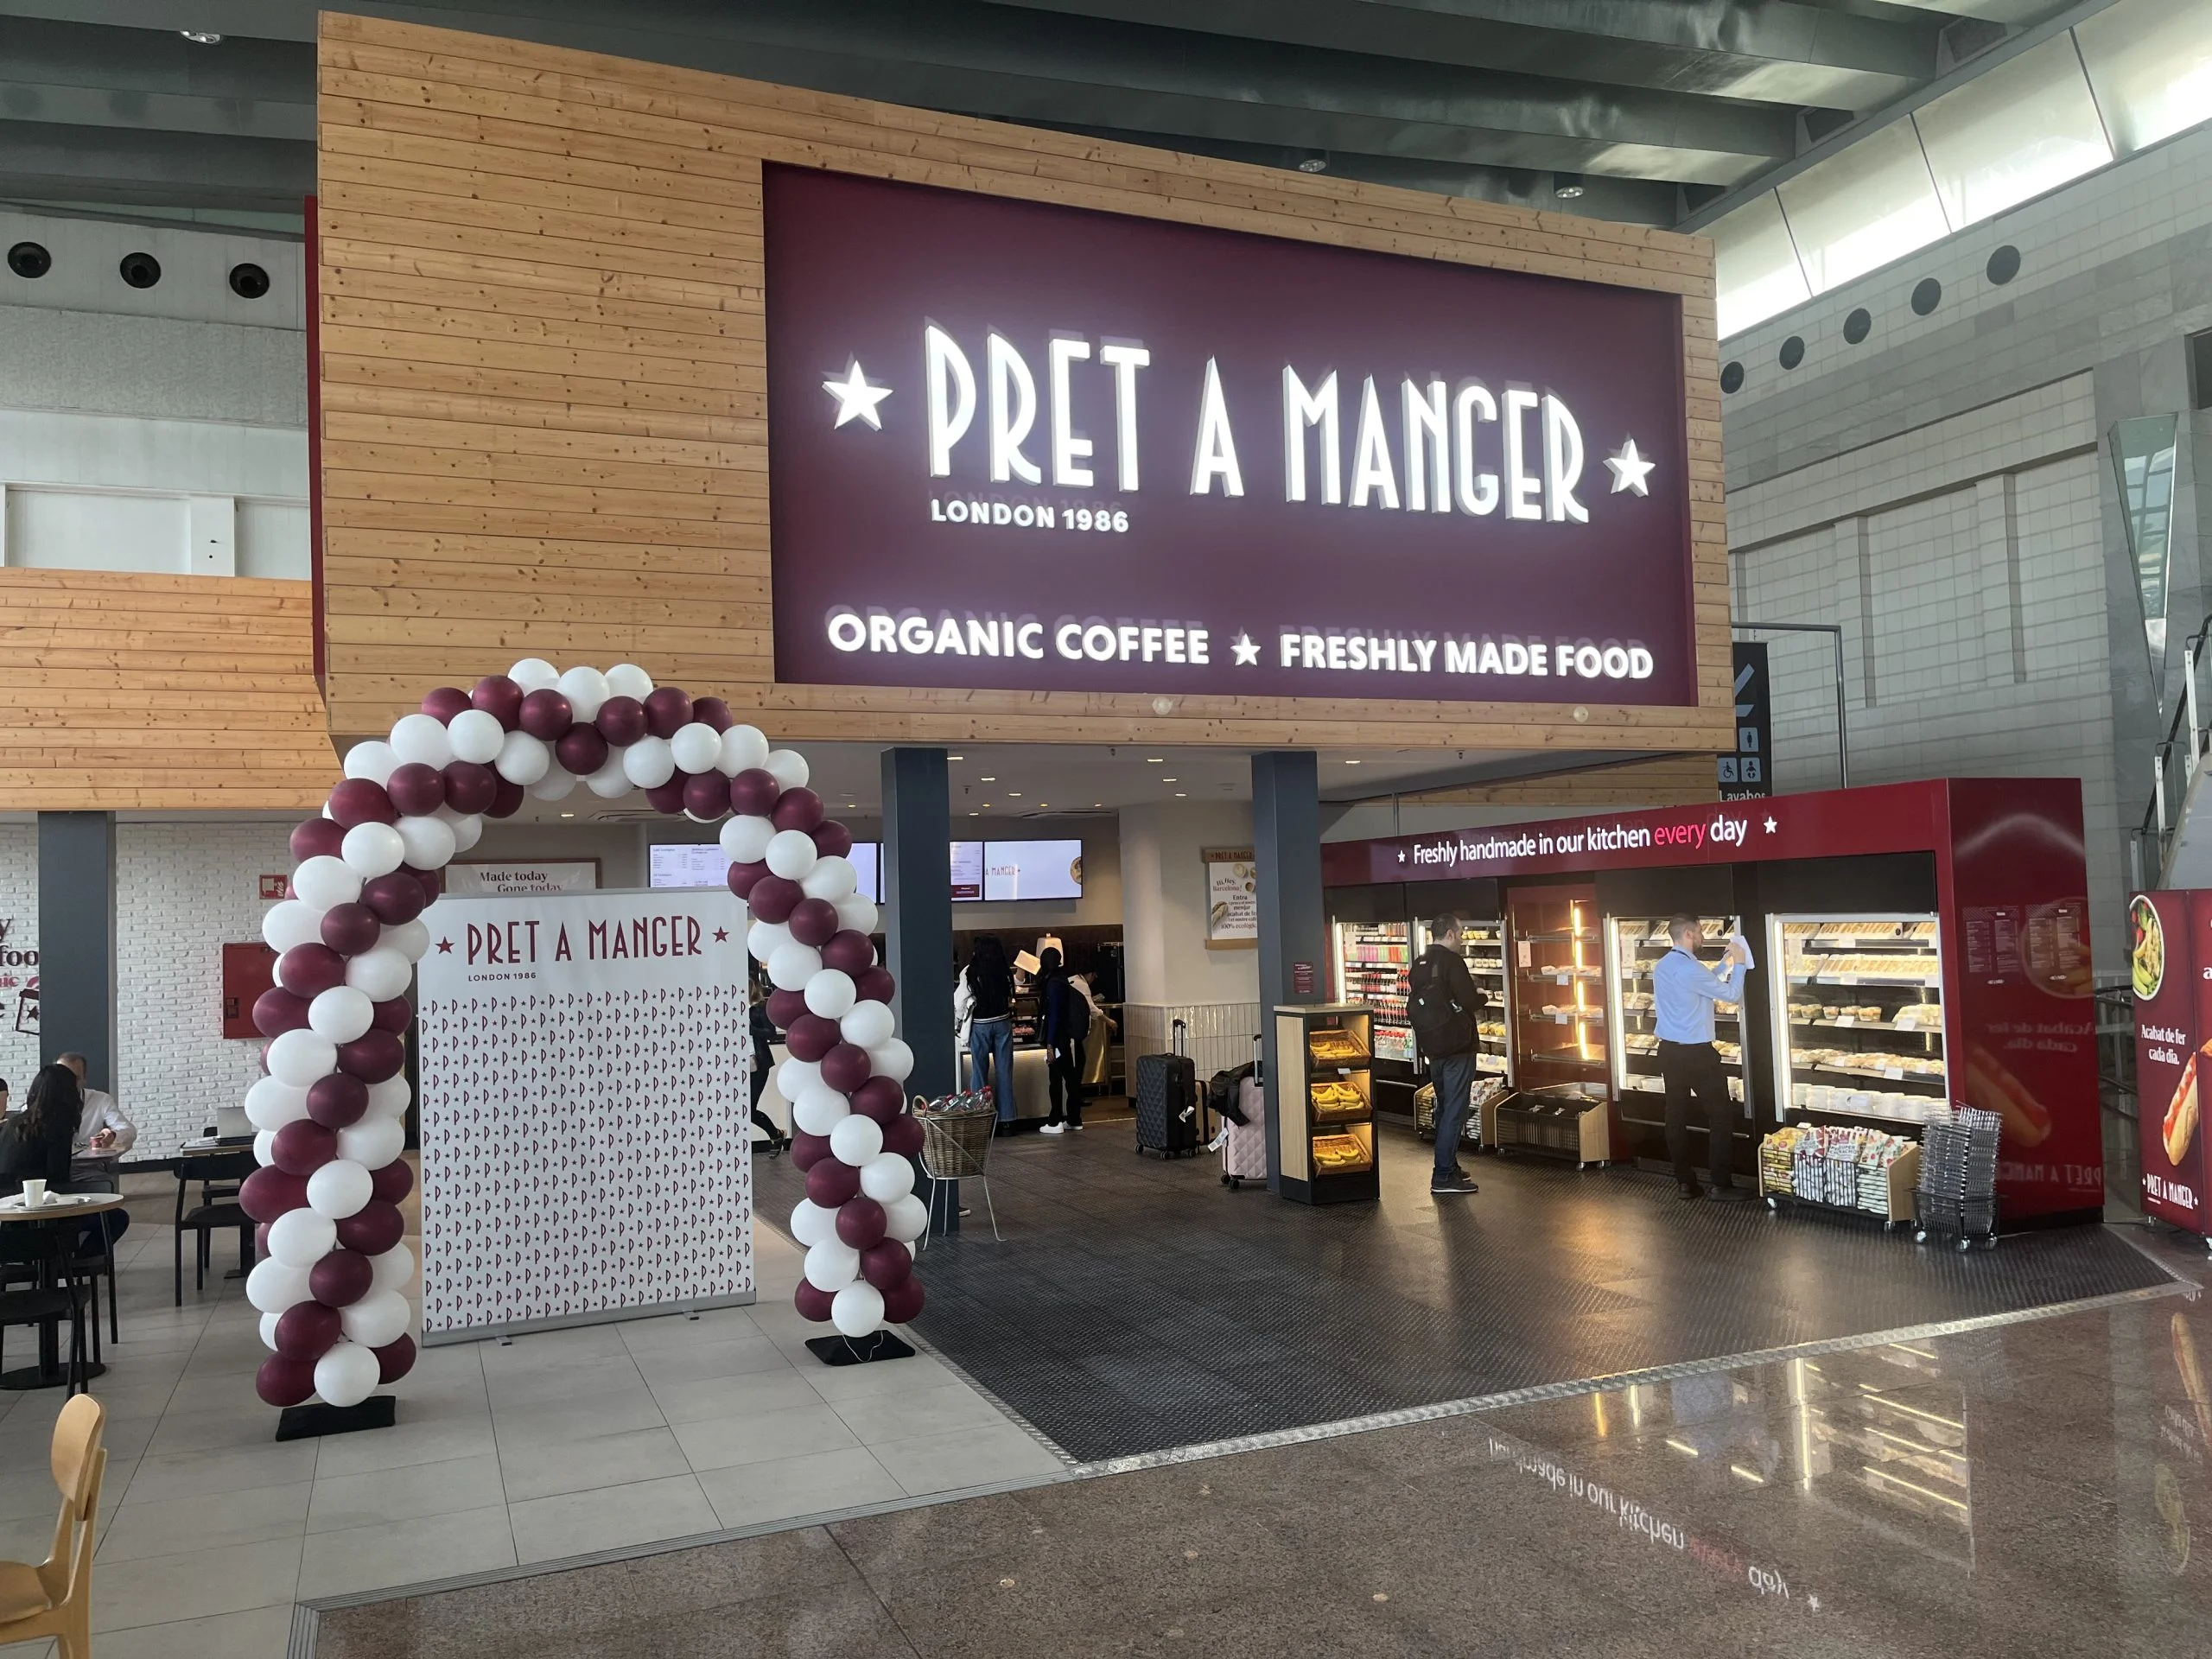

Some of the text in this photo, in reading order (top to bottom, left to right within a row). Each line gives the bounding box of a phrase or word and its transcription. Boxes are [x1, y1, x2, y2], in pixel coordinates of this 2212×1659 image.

[925, 325, 1589, 524] PRET A MANGER
[931, 499, 1129, 533] LONDON 1986
[828, 613, 1210, 664] ORGANIC COFFEE
[1280, 633, 1654, 679] FRESHLY MADE FOOD
[1414, 814, 1748, 867] Freshly handmade in our kitchen every day
[480, 870, 548, 882] Made today
[498, 883, 528, 892] Gone
[991, 866, 1015, 876] MANGER
[0, 944, 39, 966] foo
[467, 915, 702, 965] PRET A MANGER
[467, 973, 511, 982] LONDON
[431, 983, 737, 1016] P P P P P P P P P P P P P P P P P
[2141, 1024, 2186, 1045] Acabat de fer
[2148, 1046, 2165, 1063] cada
[423, 1069, 747, 1110] P P P P P P P P P P P P P P P P P P
[435, 1156, 741, 1203] P P P P P P P P P P P P P P P P P
[425, 1242, 751, 1297] P P P P P P P P P P P P P P P P P P
